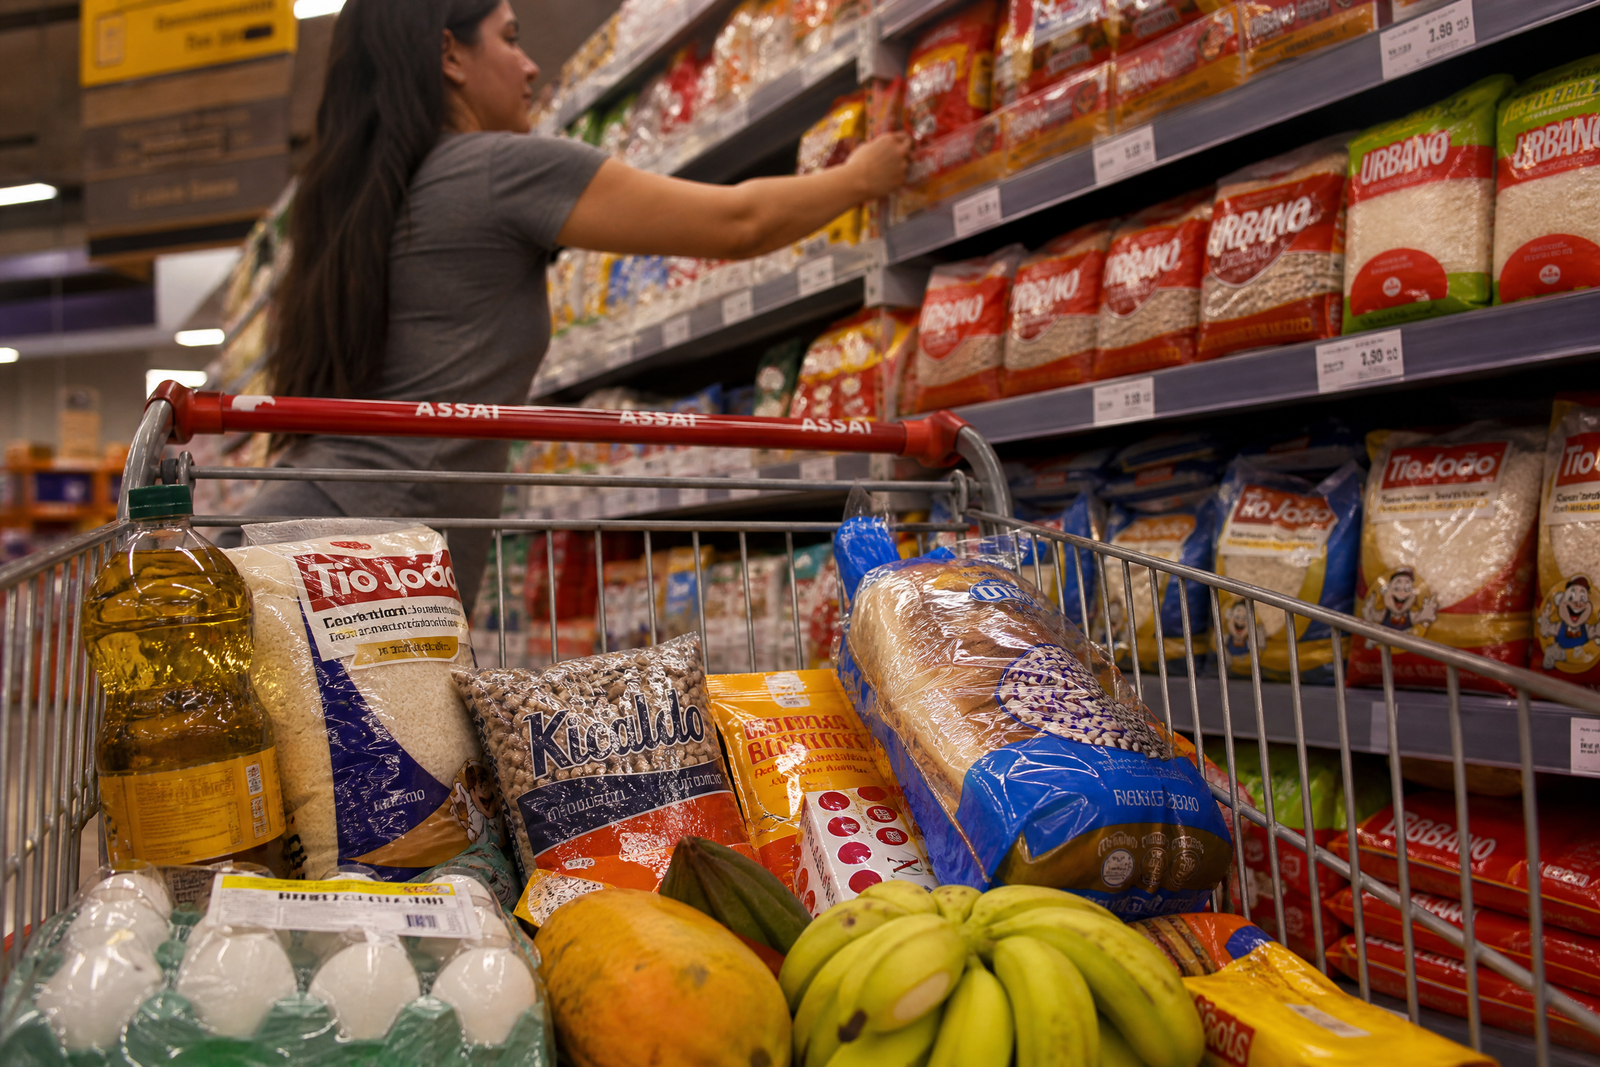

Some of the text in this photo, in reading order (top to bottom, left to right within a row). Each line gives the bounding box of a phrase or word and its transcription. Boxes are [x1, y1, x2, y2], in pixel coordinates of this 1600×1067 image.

[1360, 131, 1450, 186] URBANO
[1206, 196, 1312, 257] URBANO
[415, 401, 499, 419] ASSAI
[619, 410, 696, 428] ASSAI
[801, 417, 872, 434] ASSAI
[1563, 444, 1595, 477] Tio
[307, 562, 378, 598] Tio
[523, 688, 705, 780] Kicaldo
